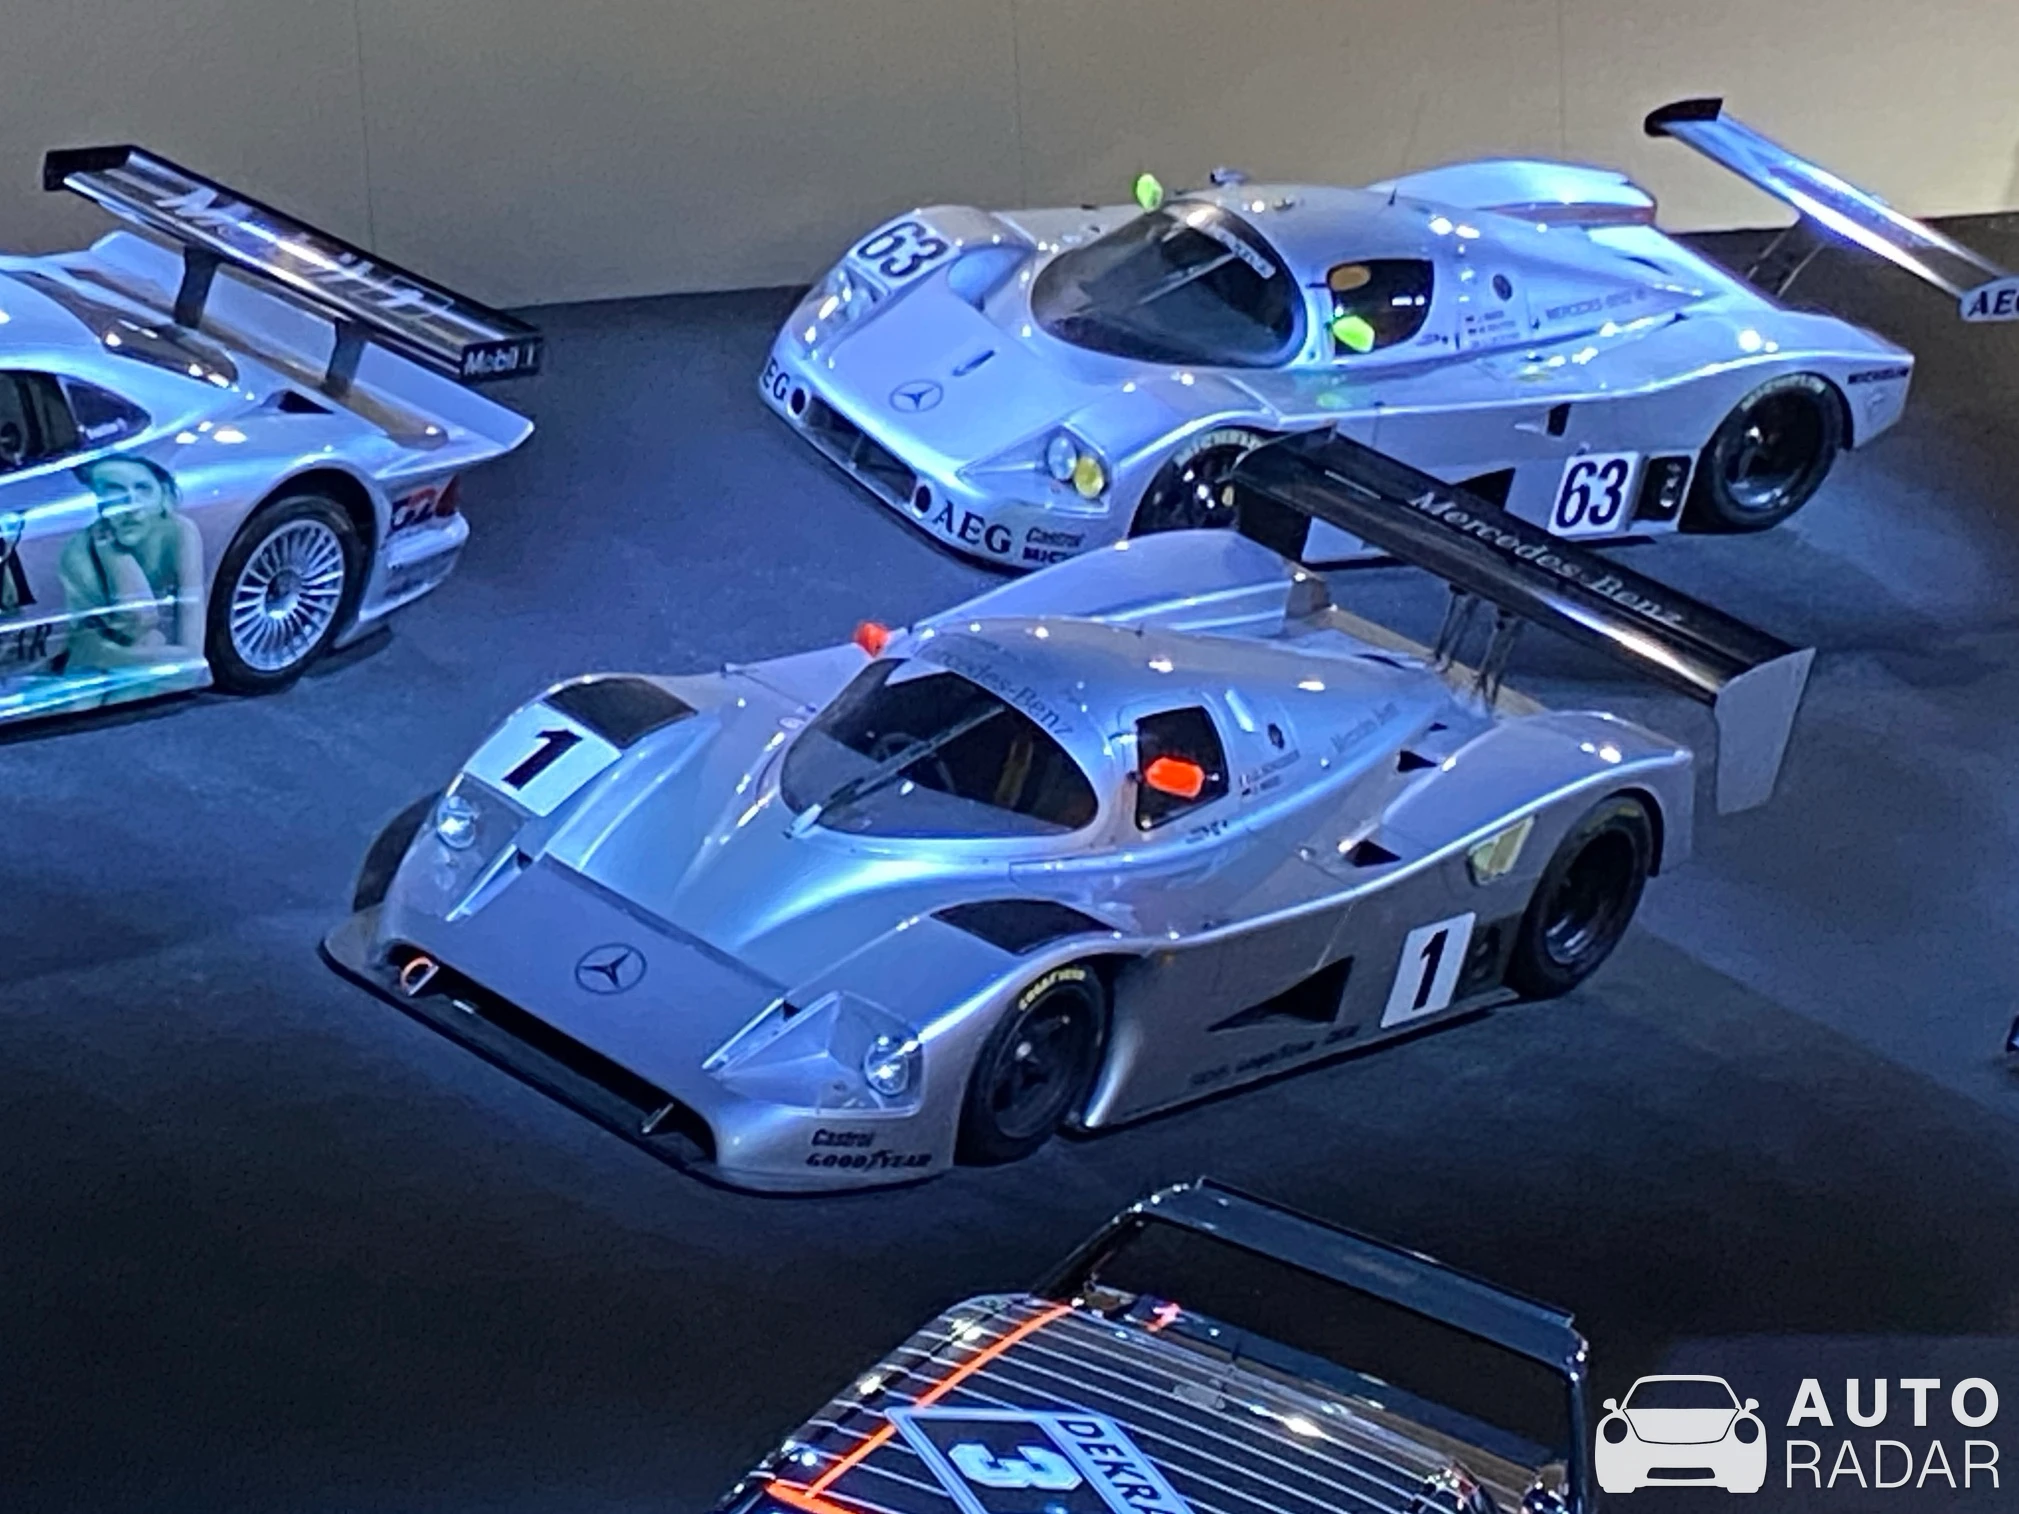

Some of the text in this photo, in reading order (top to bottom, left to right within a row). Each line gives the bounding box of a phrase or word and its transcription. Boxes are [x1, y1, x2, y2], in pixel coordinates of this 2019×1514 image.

[856, 221, 949, 278] 63
[1967, 287, 2019, 317] AE
[763, 358, 791, 402] EG
[1555, 458, 1629, 529] 63
[932, 499, 1012, 554] AEG
[1411, 491, 1685, 625] Mercedes-Benz
[501, 728, 583, 791] 1
[1411, 928, 1449, 1013] 1
[806, 1150, 932, 1172] GOODYEAR
[948, 1442, 1084, 1490] 3
[1056, 1418, 1176, 1514] DEKR
